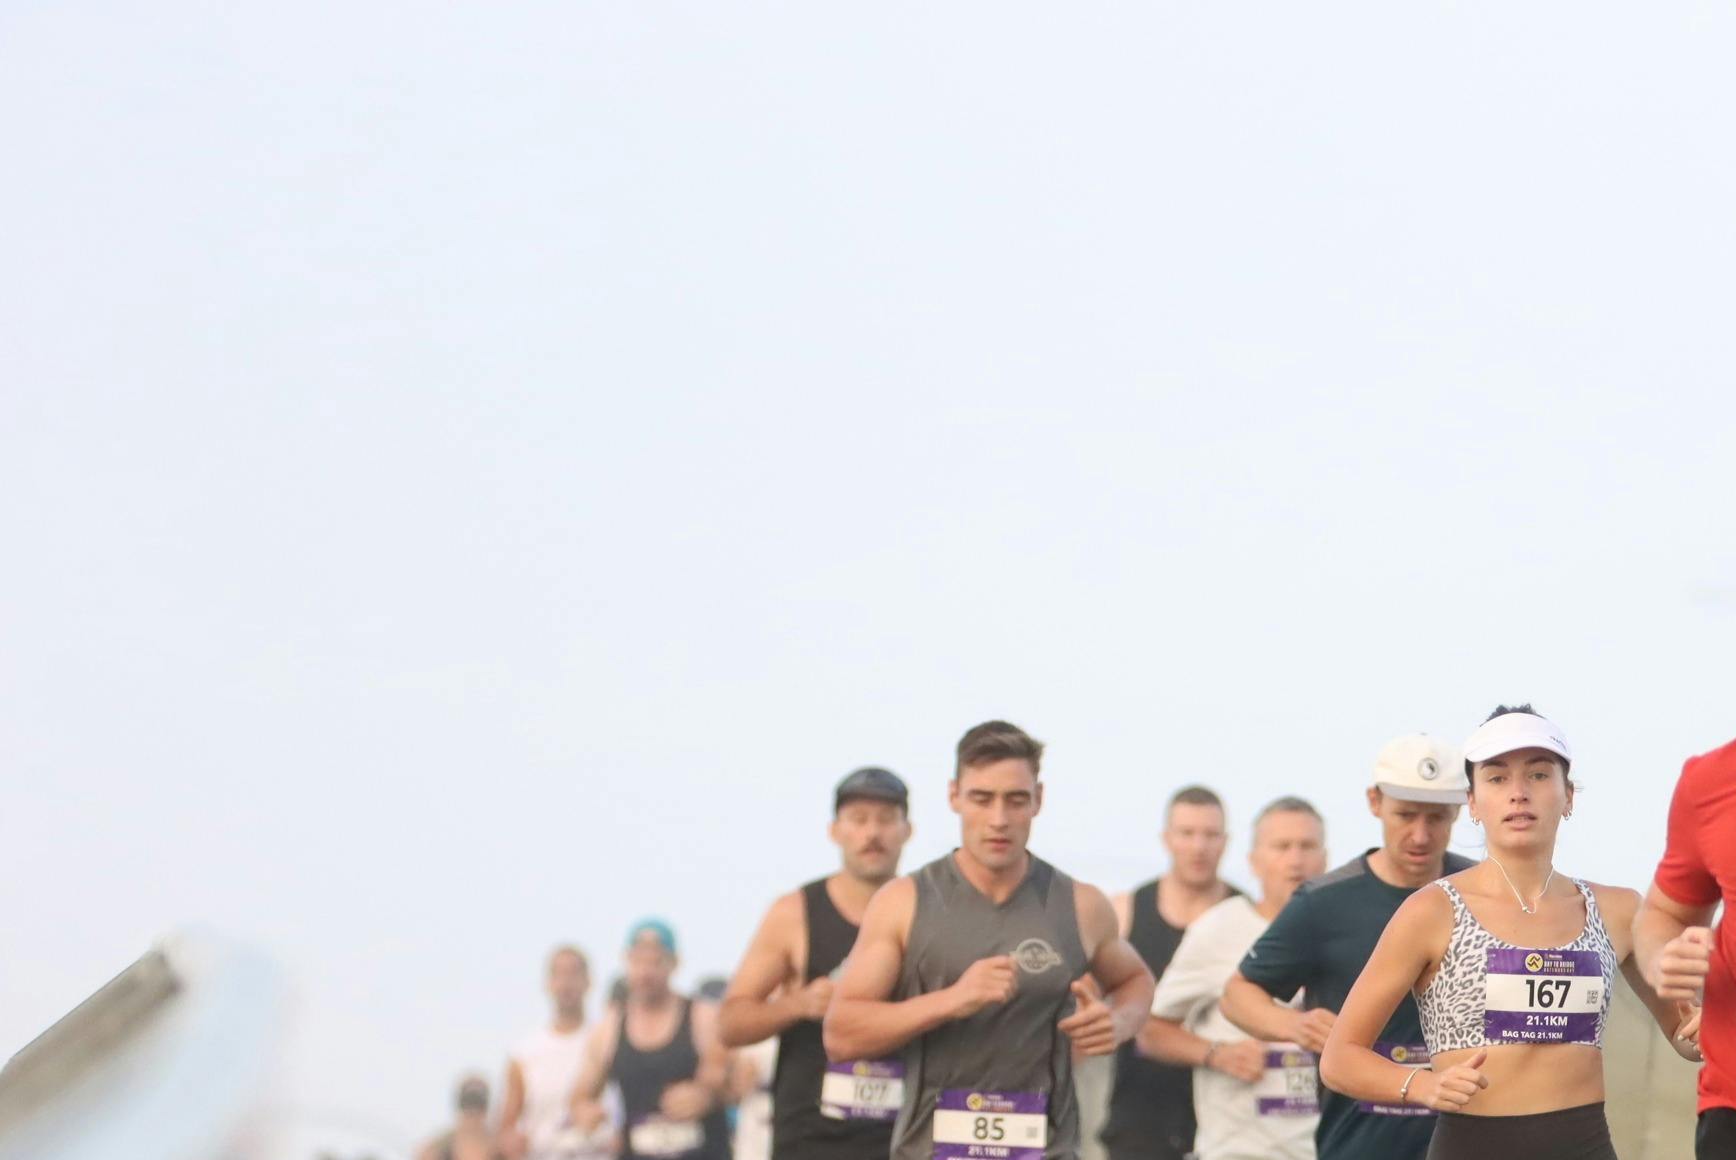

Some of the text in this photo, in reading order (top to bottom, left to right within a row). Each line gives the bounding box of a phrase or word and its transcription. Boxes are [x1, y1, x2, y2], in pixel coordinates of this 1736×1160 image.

[1525, 979, 1572, 1009] 167
[1526, 1015, 1568, 1027] 21.1KM
[1502, 1030, 1519, 1038] BAG
[1537, 1031, 1563, 1040] 21.1KM
[974, 1116, 1005, 1140] 85
